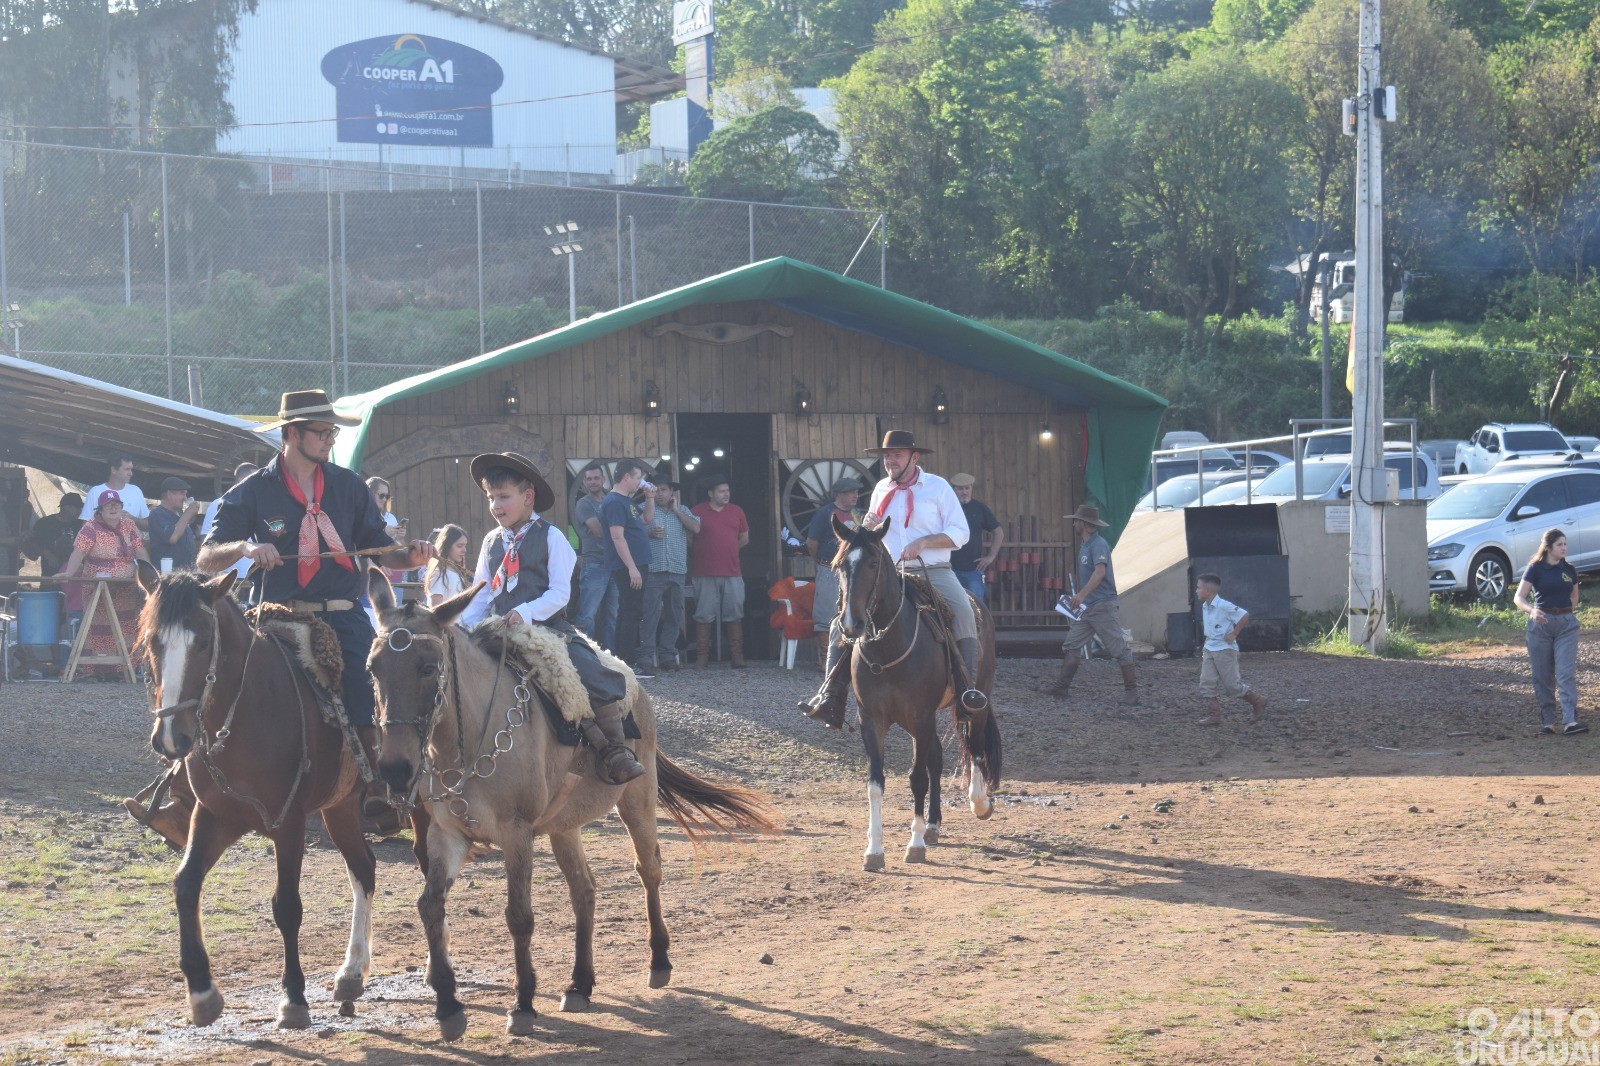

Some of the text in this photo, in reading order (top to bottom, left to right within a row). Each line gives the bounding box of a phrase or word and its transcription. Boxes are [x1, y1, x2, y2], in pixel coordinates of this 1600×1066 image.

[363, 58, 454, 83] COOPER A1
[399, 125, 458, 136] @cooperativaa1
